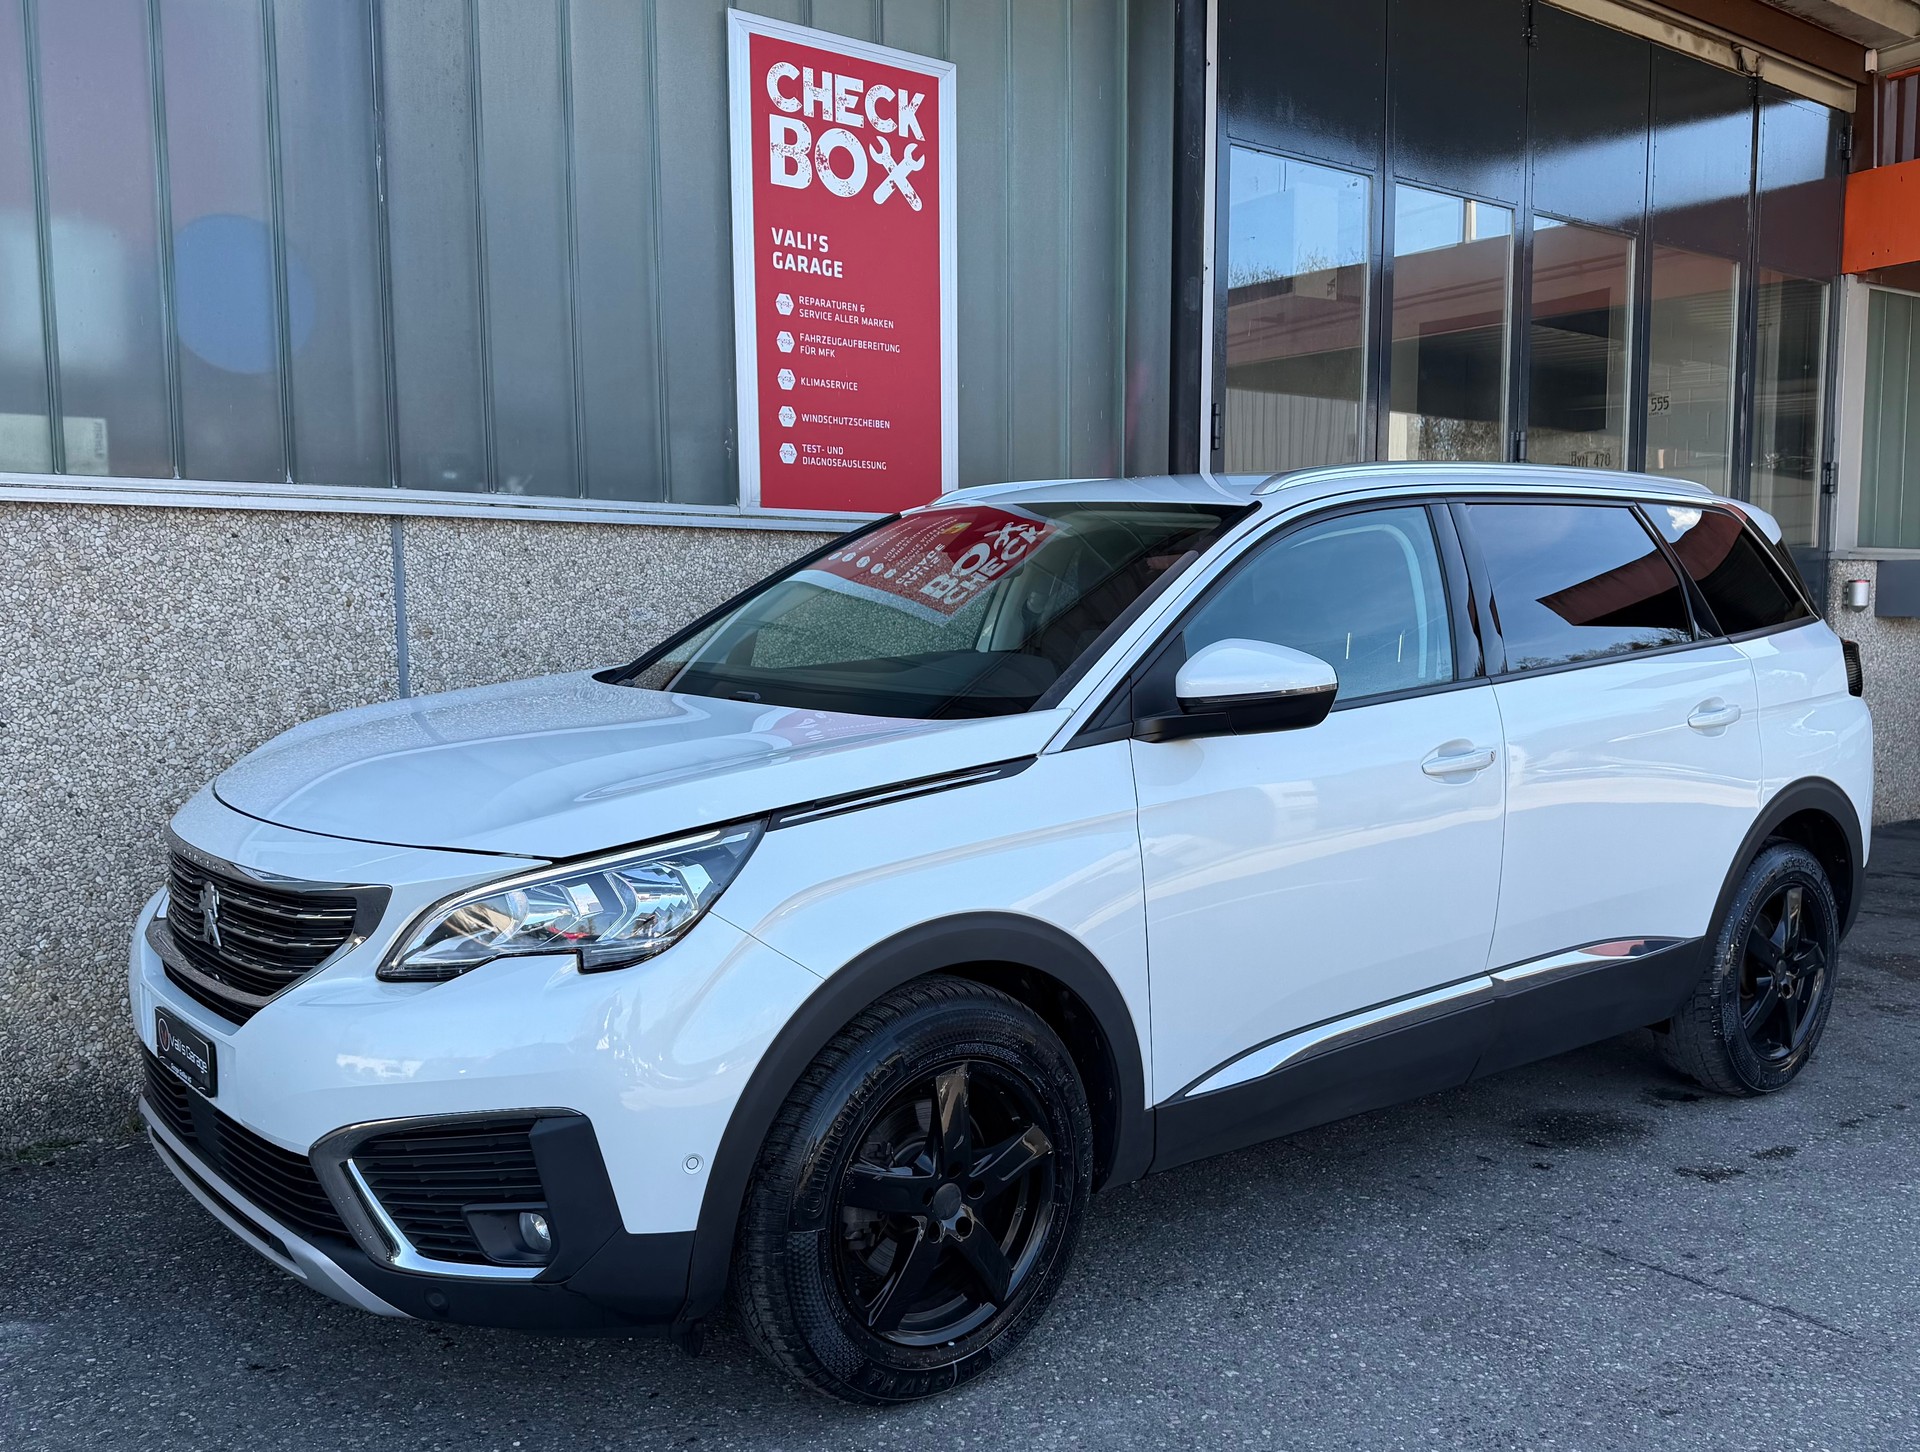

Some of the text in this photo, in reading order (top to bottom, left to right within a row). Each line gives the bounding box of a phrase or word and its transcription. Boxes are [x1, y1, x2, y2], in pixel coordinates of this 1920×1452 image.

[766, 62, 925, 141] CHECK
[769, 114, 925, 211] BOX
[771, 227, 829, 253] VALI'S
[772, 251, 843, 279] GARAGE
[799, 296, 866, 313] REPARATUREN &
[799, 308, 894, 329] SERVICE ALLER MARKEN
[799, 333, 900, 353] FAHRZEUGAUFBEREITUNG
[800, 345, 836, 358] FÜR MFK
[800, 377, 858, 391] KLIMASERVICE
[1651, 395, 1670, 412] 555
[801, 413, 890, 429] WINDSCHUTZSCHEIBEN
[802, 444, 844, 455] TEST- UND
[802, 457, 887, 470] DIAGNOSEAUSLESUNG
